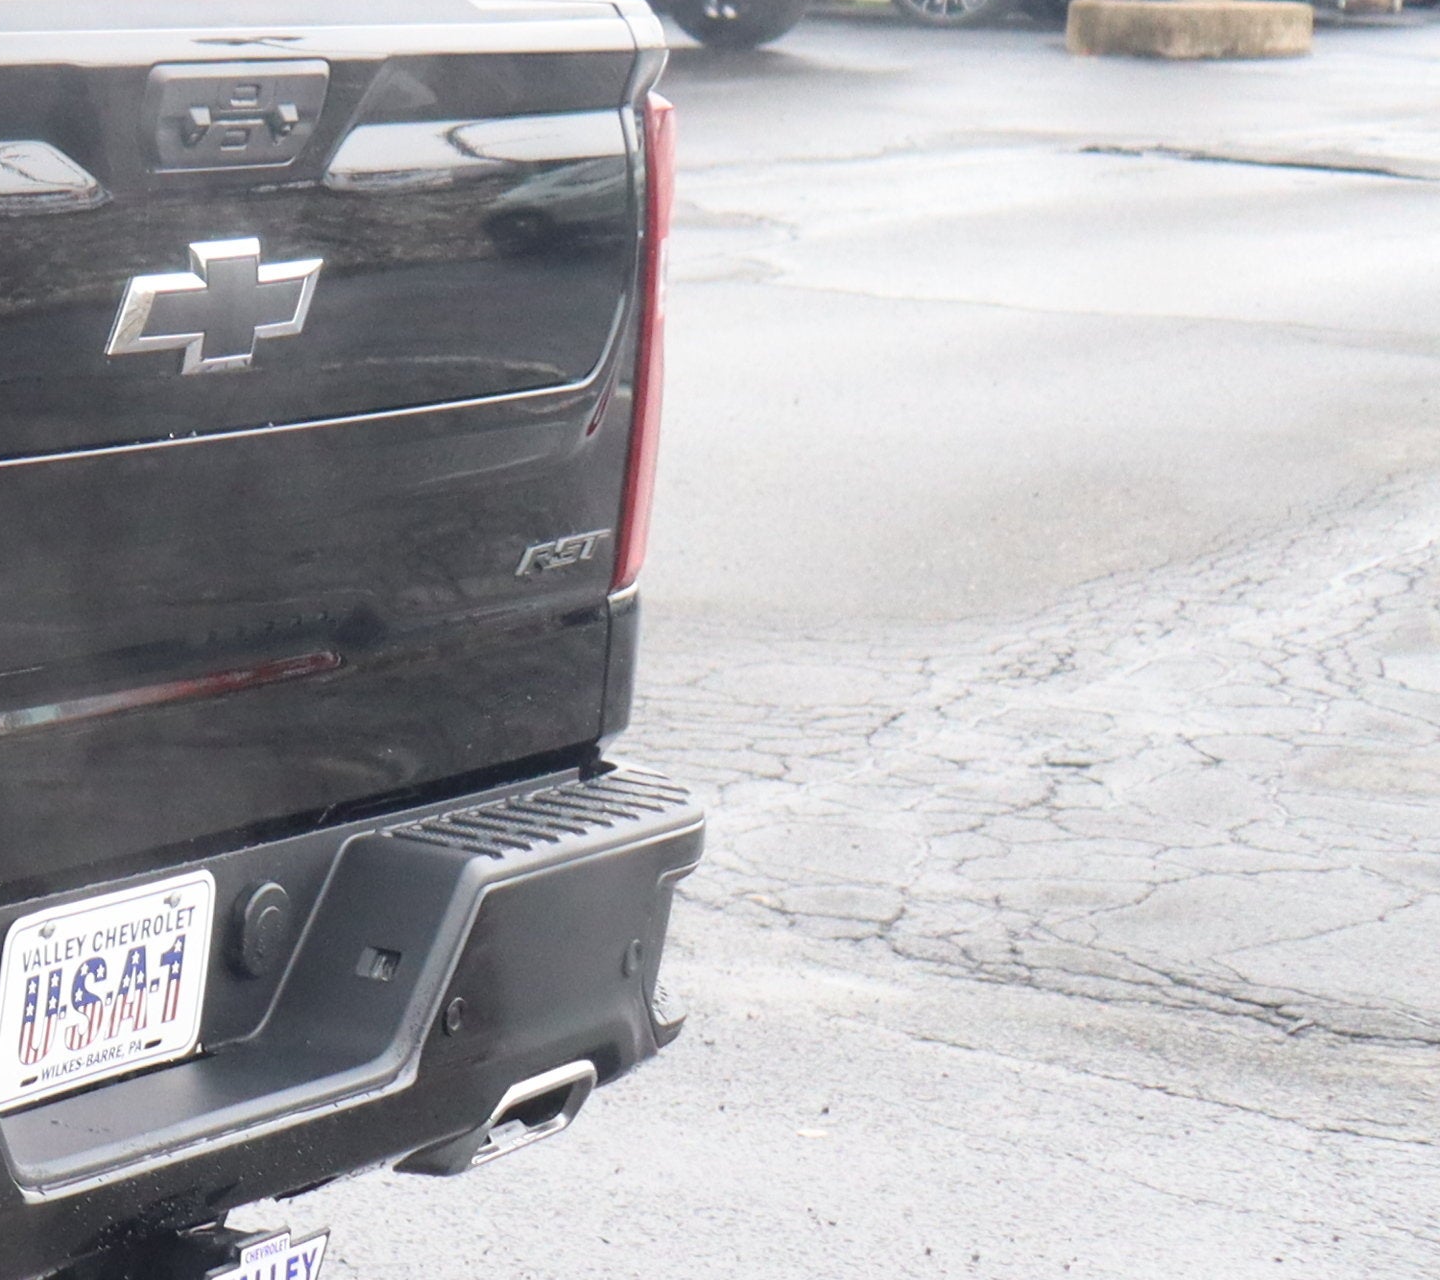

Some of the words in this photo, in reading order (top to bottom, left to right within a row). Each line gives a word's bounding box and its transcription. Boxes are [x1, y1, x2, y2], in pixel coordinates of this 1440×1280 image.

[514, 528, 612, 577] RST
[22, 934, 87, 973] VALLEY
[91, 905, 196, 953] CHEVROLET
[128, 1039, 143, 1056] PA
[244, 1238, 289, 1265] CHEVROLET
